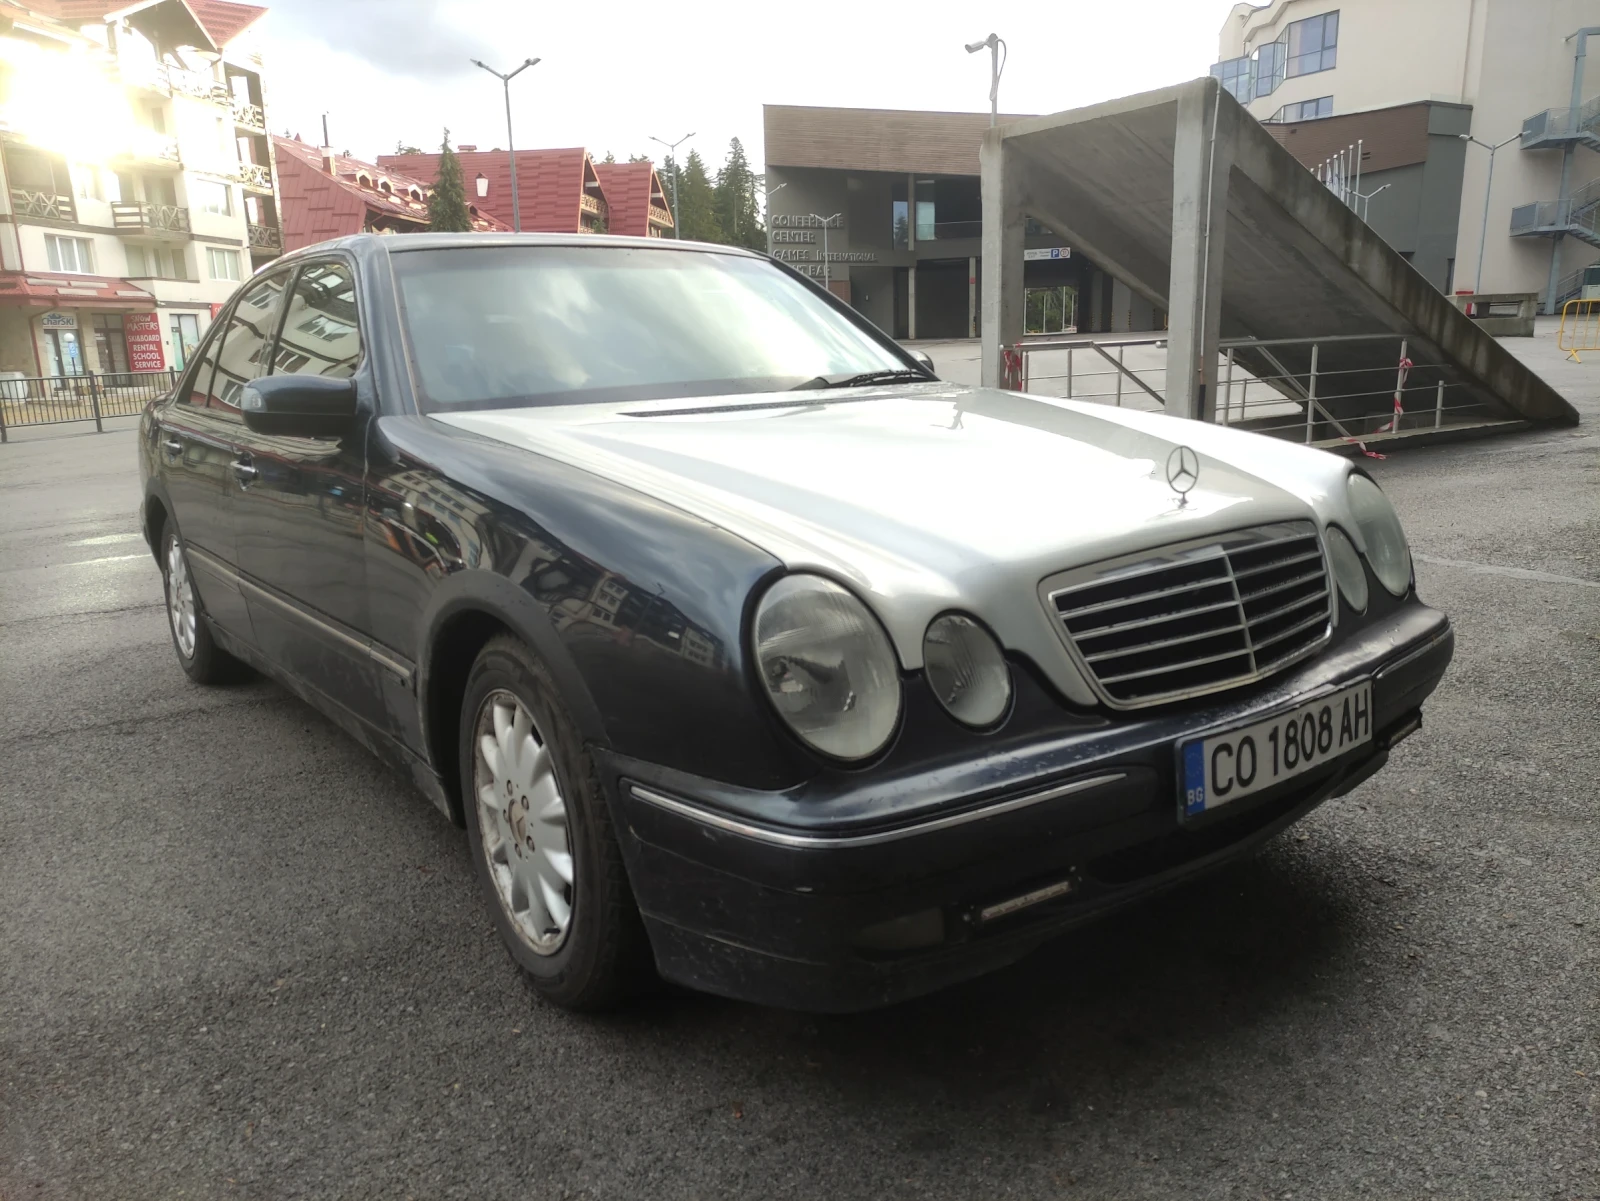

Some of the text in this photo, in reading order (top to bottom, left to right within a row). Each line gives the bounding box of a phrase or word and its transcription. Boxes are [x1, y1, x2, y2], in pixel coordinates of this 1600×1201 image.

[772, 230, 816, 243] CENTER
[772, 249, 810, 261] GAMES
[808, 264, 832, 277] BAR
[42, 317, 74, 326] CharSKI
[126, 322, 159, 331] MASTERS
[127, 335, 160, 343] SKI&BOARD
[1211, 688, 1369, 797] CO 1808 AH
[1186, 788, 1205, 807] BG
